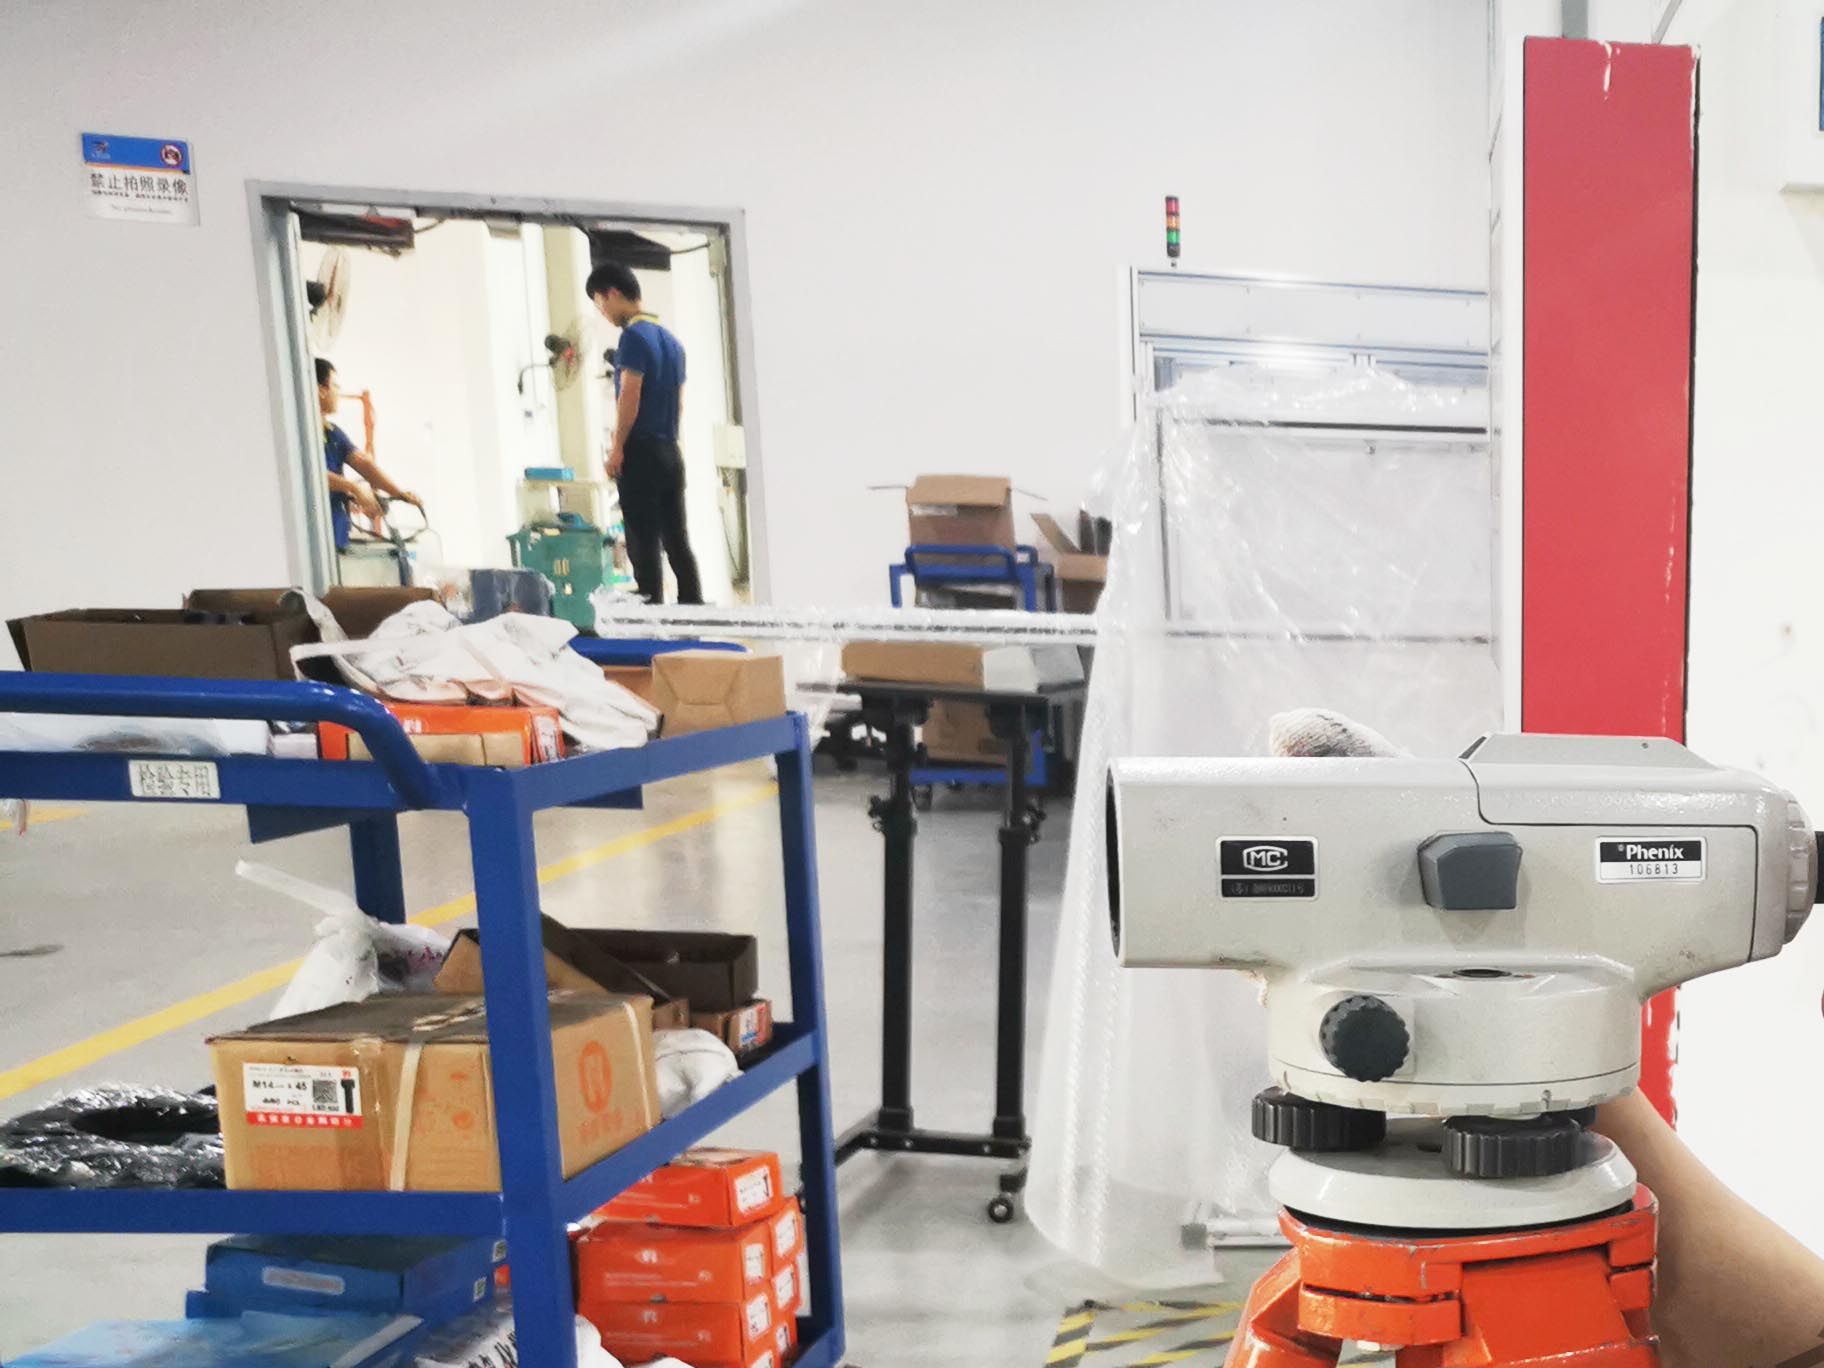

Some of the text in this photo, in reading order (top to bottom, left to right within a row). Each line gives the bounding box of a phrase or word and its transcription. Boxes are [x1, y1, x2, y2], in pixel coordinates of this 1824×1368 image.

[90, 172, 189, 197] 禁止拍照录像
[1626, 843, 1685, 860] Phenix
[1629, 862, 1679, 876] 106813
